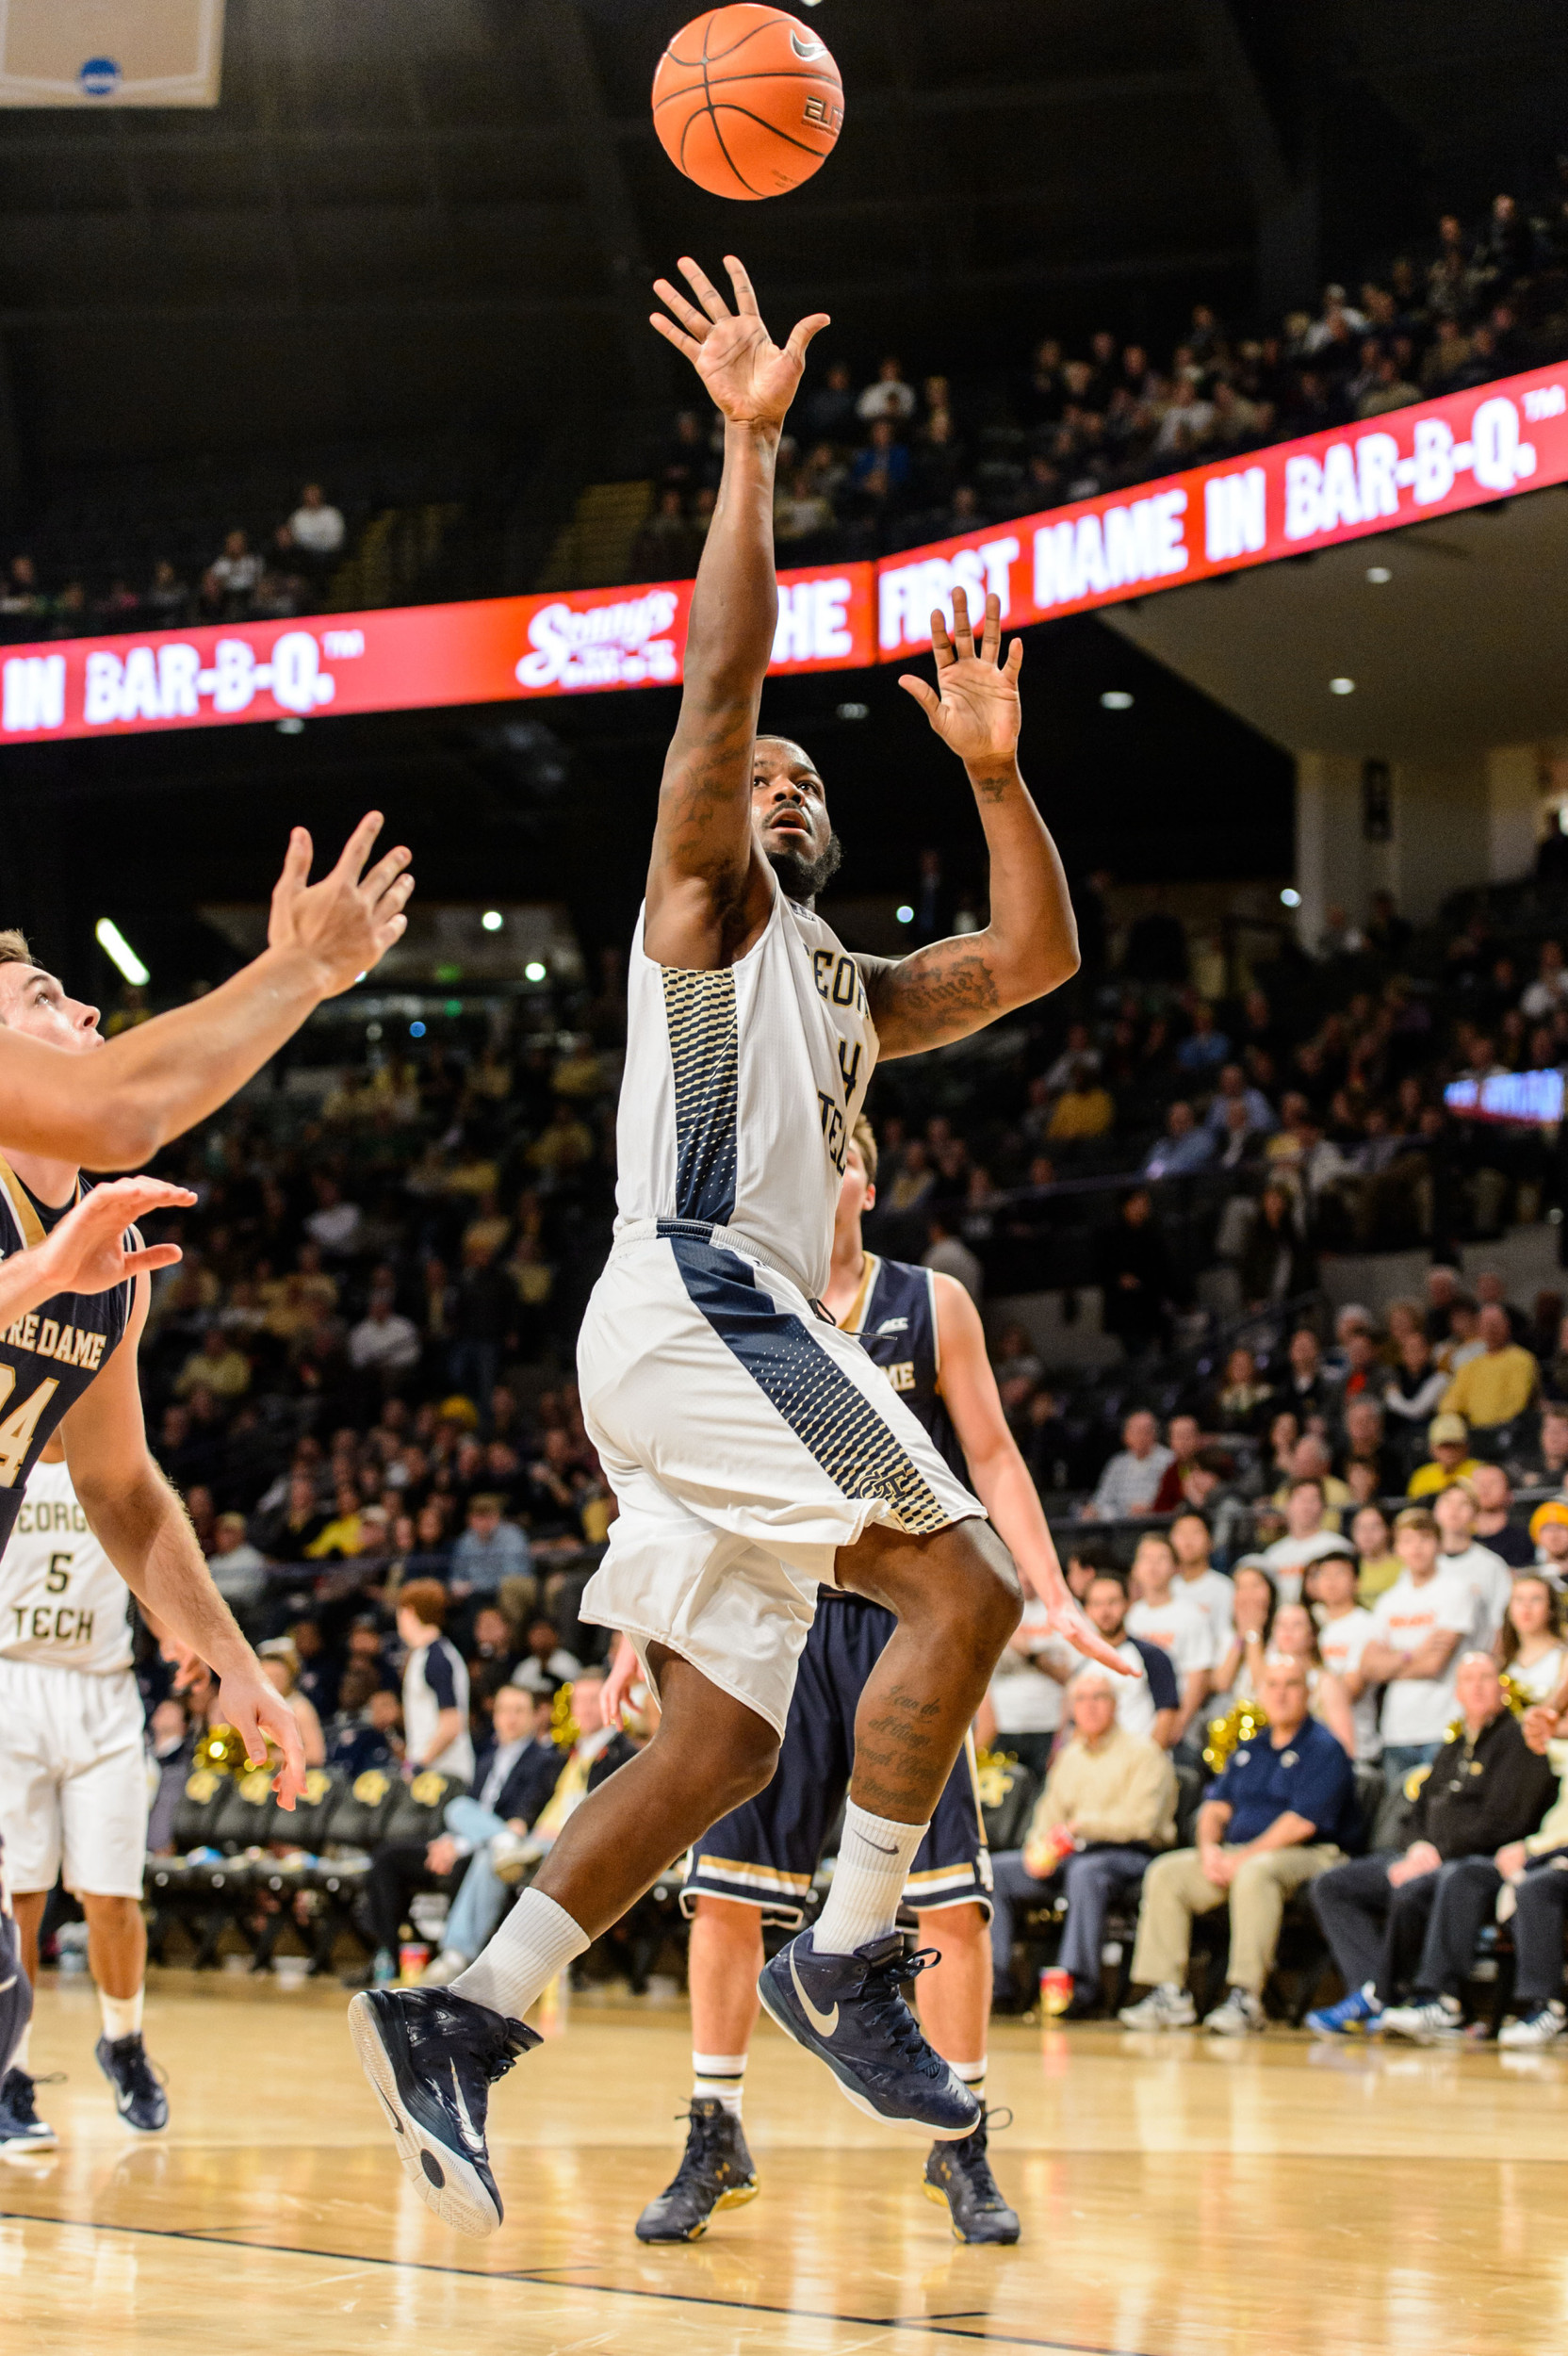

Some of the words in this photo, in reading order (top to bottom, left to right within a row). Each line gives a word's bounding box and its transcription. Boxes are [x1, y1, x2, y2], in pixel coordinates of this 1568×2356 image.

[772, 579, 852, 663] HE
[879, 536, 1020, 650] FIRST
[1034, 488, 1189, 610] NAME
[1204, 466, 1266, 563] IN
[3, 655, 65, 731] IN
[838, 1039, 863, 1108] 4
[36, 1317, 106, 1370] DAME
[46, 1550, 74, 1595] 5
[12, 1606, 93, 1642] TECH
